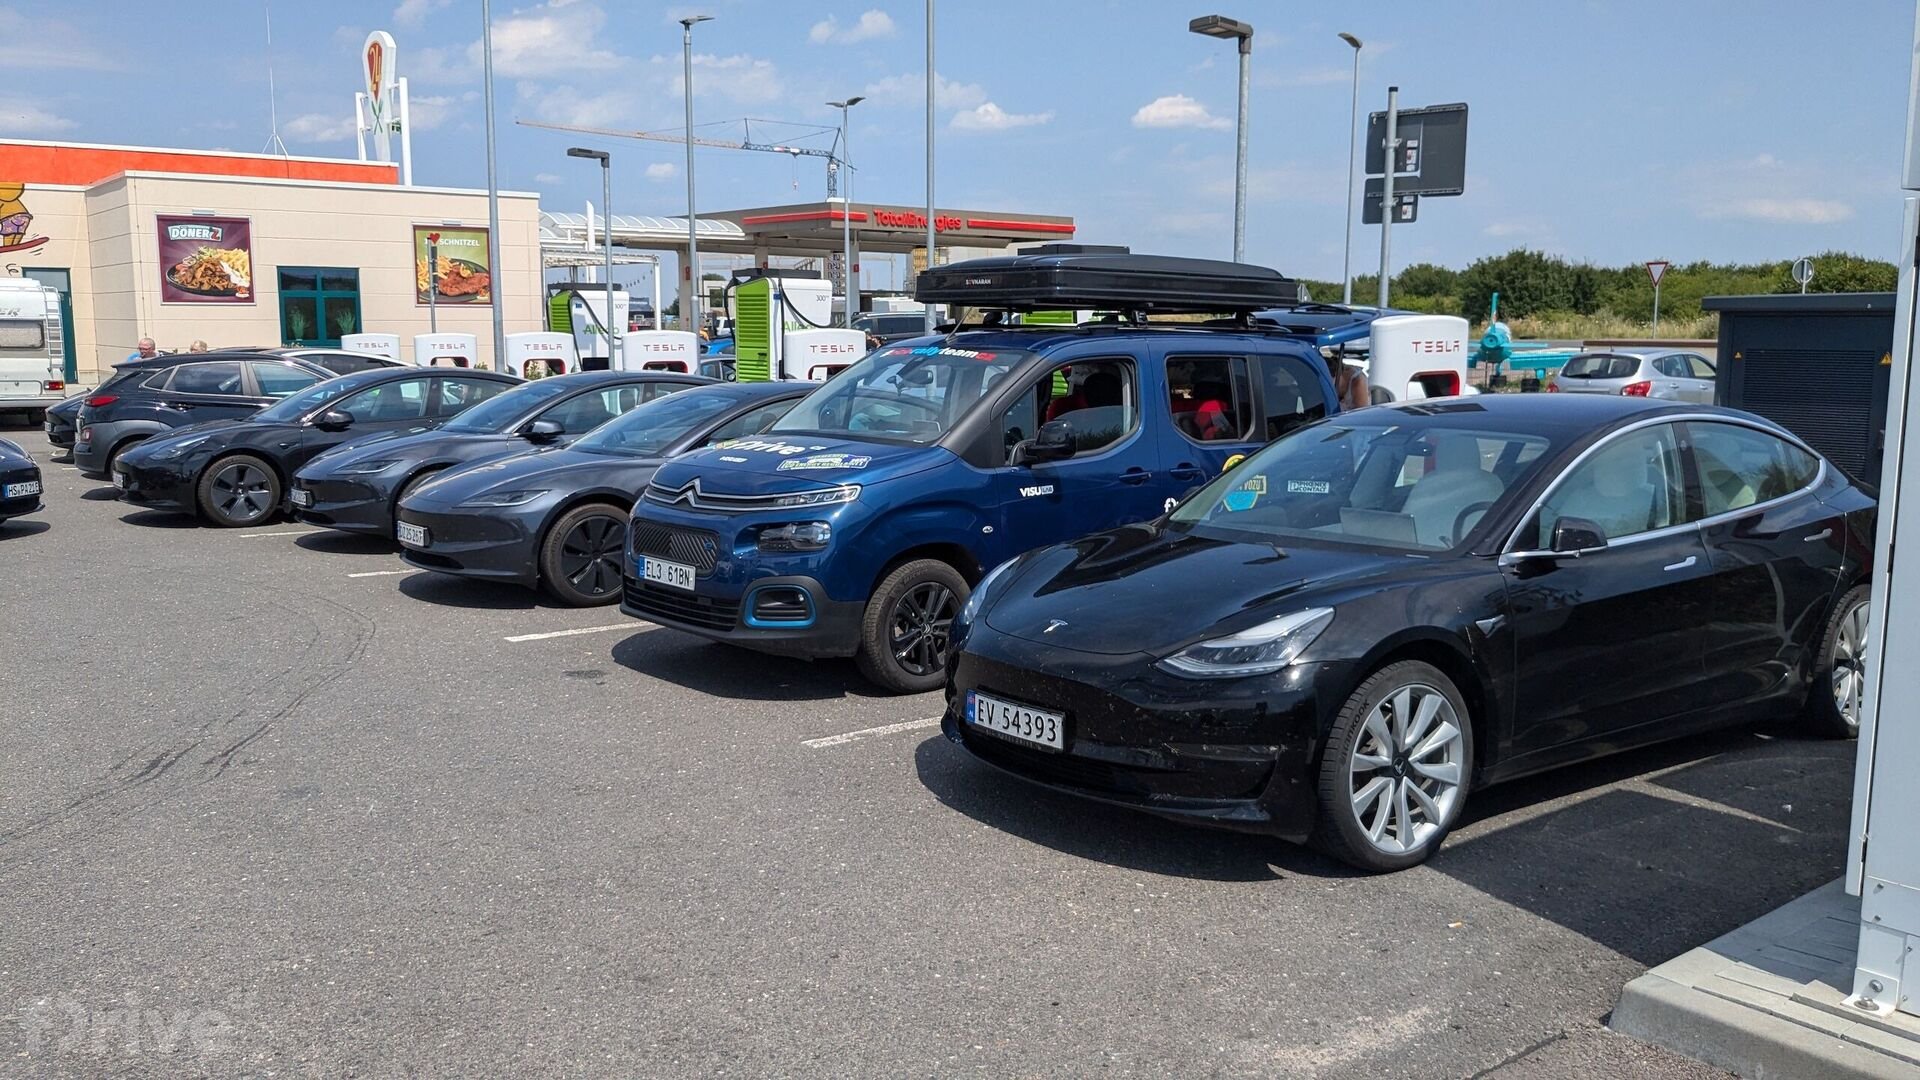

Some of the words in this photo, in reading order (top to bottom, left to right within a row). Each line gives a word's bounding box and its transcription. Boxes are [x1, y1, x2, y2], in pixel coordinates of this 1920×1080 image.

[440, 238, 481, 248] SCHNITZEL
[430, 342, 466, 350] TESLA
[523, 343, 563, 351] TESLA
[643, 344, 685, 352] TESLA
[809, 344, 855, 353] TESLA
[1411, 340, 1460, 354] TESLA
[646, 560, 662, 580] EL3
[667, 565, 691, 588] 61BN
[978, 698, 995, 726] EV
[1001, 706, 1057, 742] 54393
